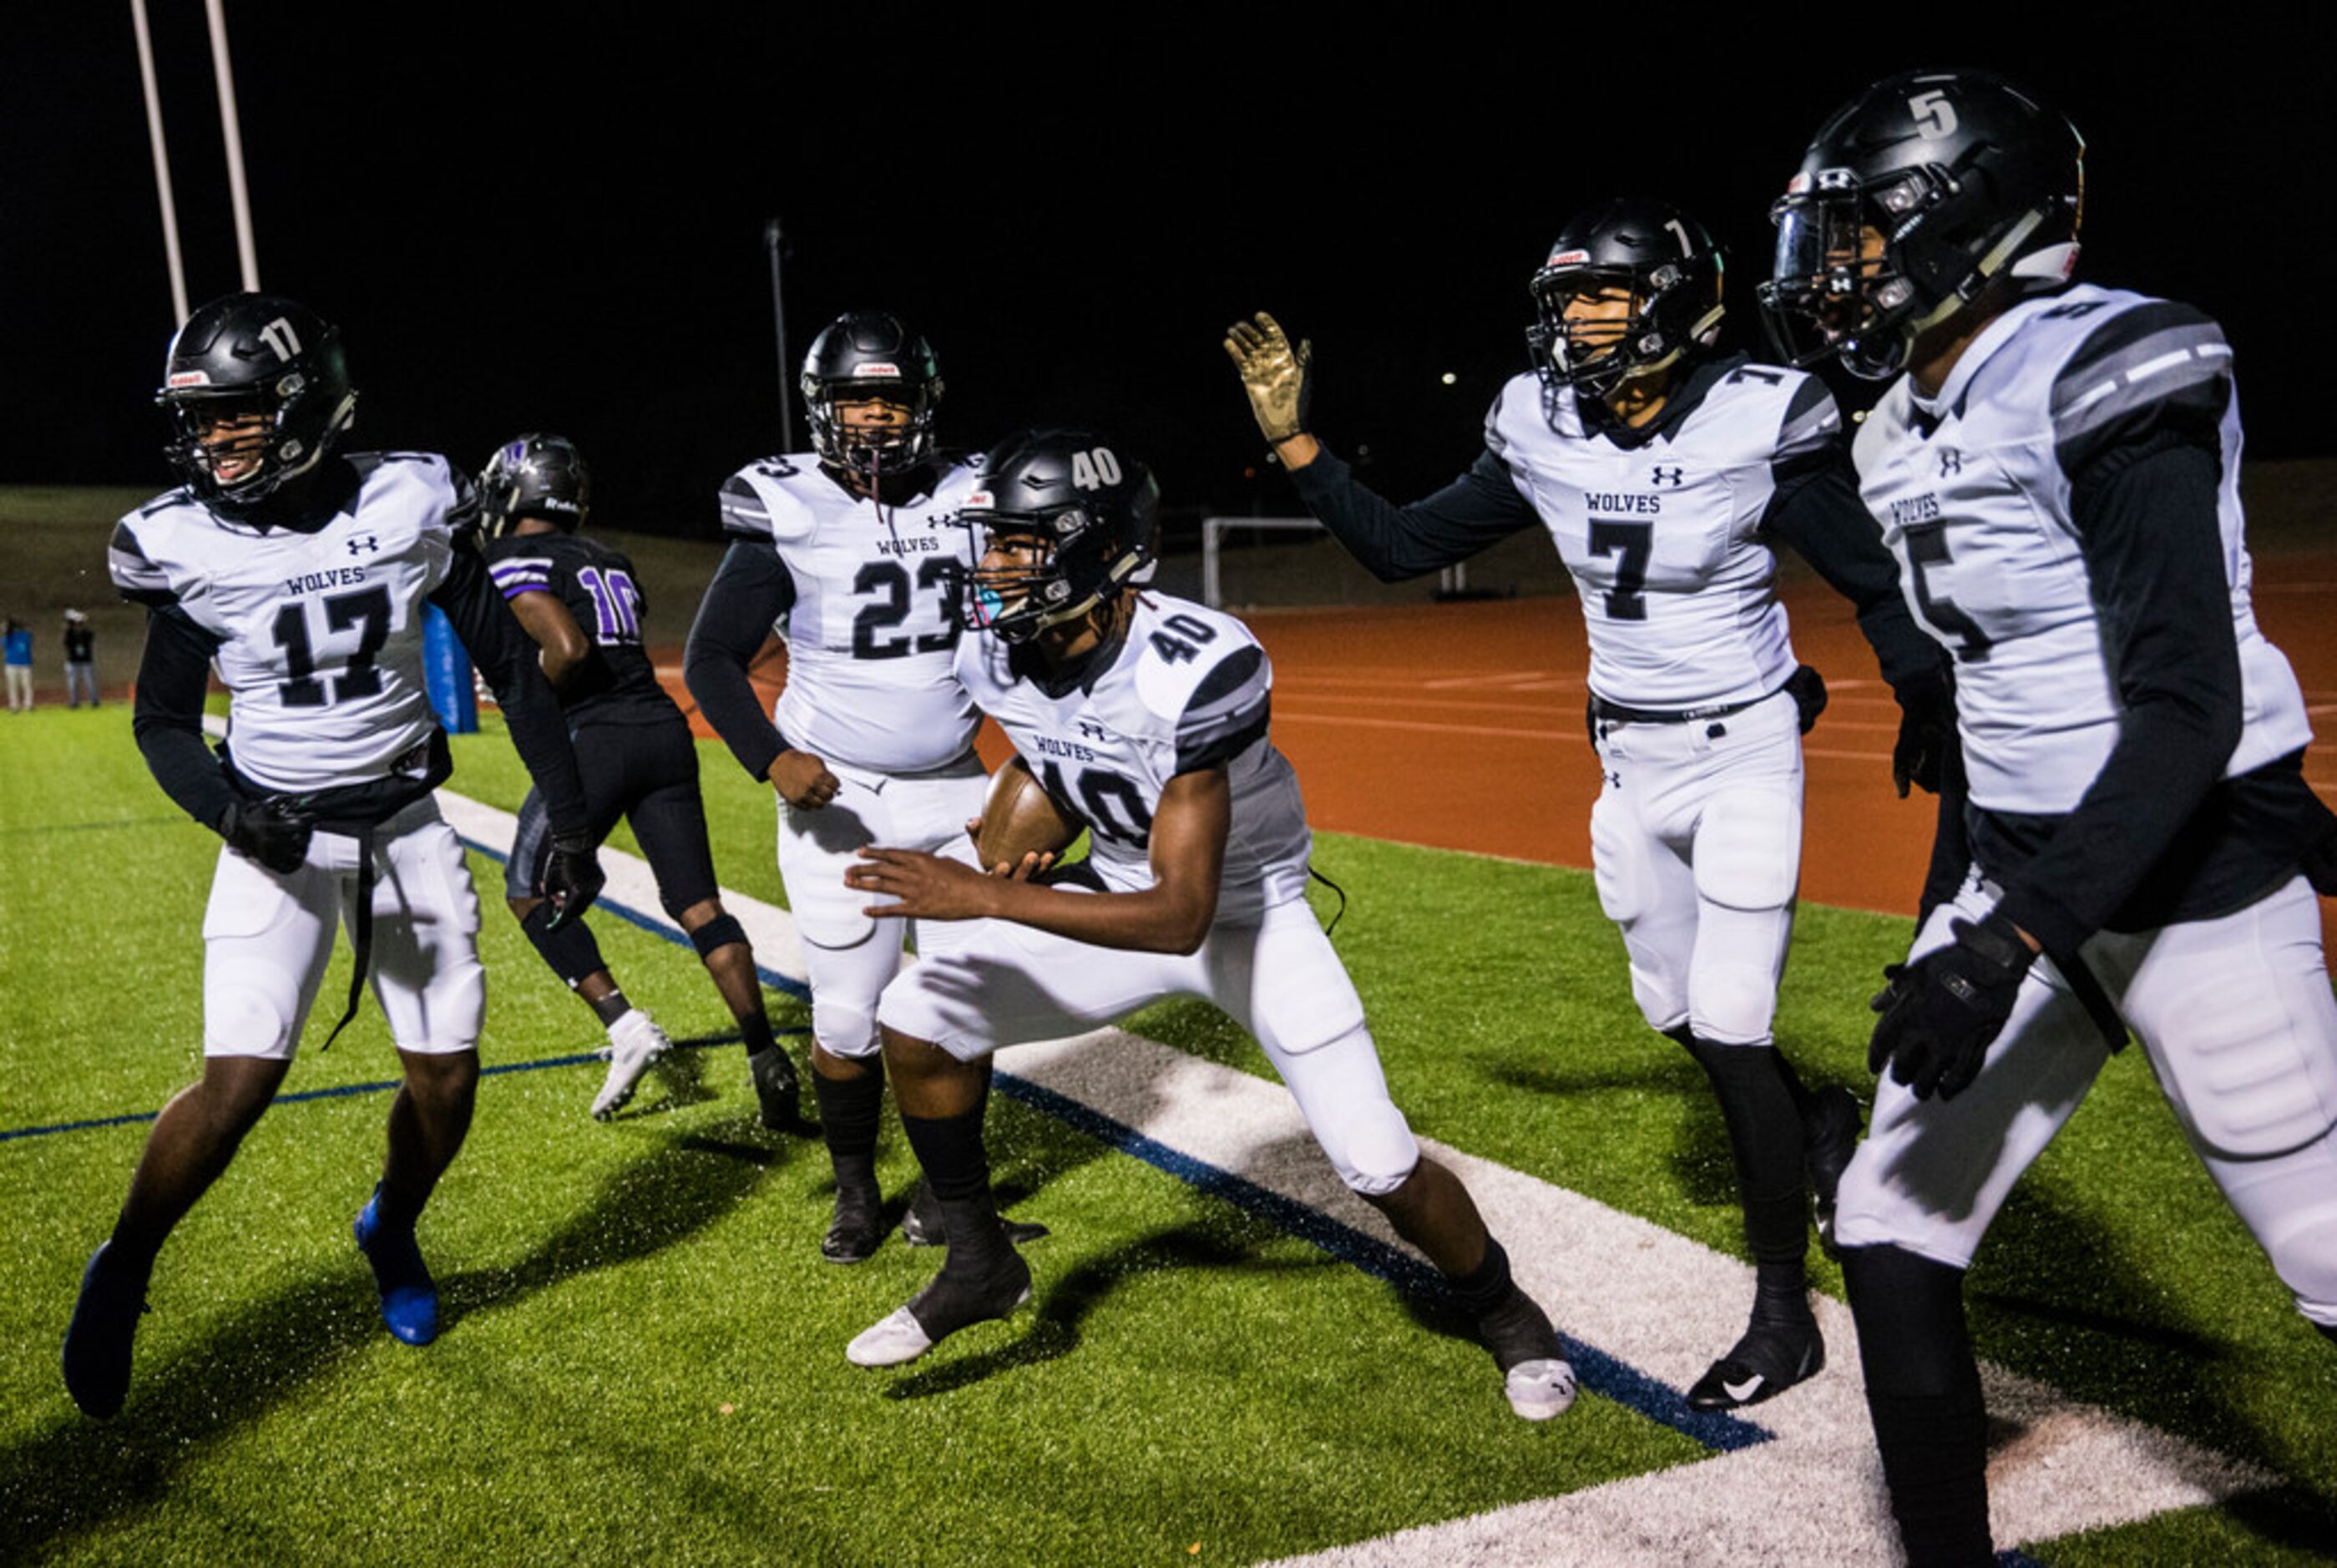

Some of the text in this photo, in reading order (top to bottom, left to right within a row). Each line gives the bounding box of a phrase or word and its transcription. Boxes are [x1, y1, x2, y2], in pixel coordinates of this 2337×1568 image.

[1909, 90, 1960, 140] 5
[1664, 219, 1692, 258] 7
[256, 316, 303, 362] 17
[1071, 448, 1122, 492] 40
[1586, 493, 1661, 513] WOLVES
[1890, 492, 1940, 524] WOLVES
[877, 536, 940, 555] WOLVES
[287, 566, 366, 596] WOLVES
[1588, 518, 1653, 621] 7
[1904, 519, 1991, 663] 5
[852, 554, 965, 660] 23
[271, 584, 392, 707] 17
[1147, 614, 1219, 666] 40
[1033, 734, 1095, 762] WOLVES
